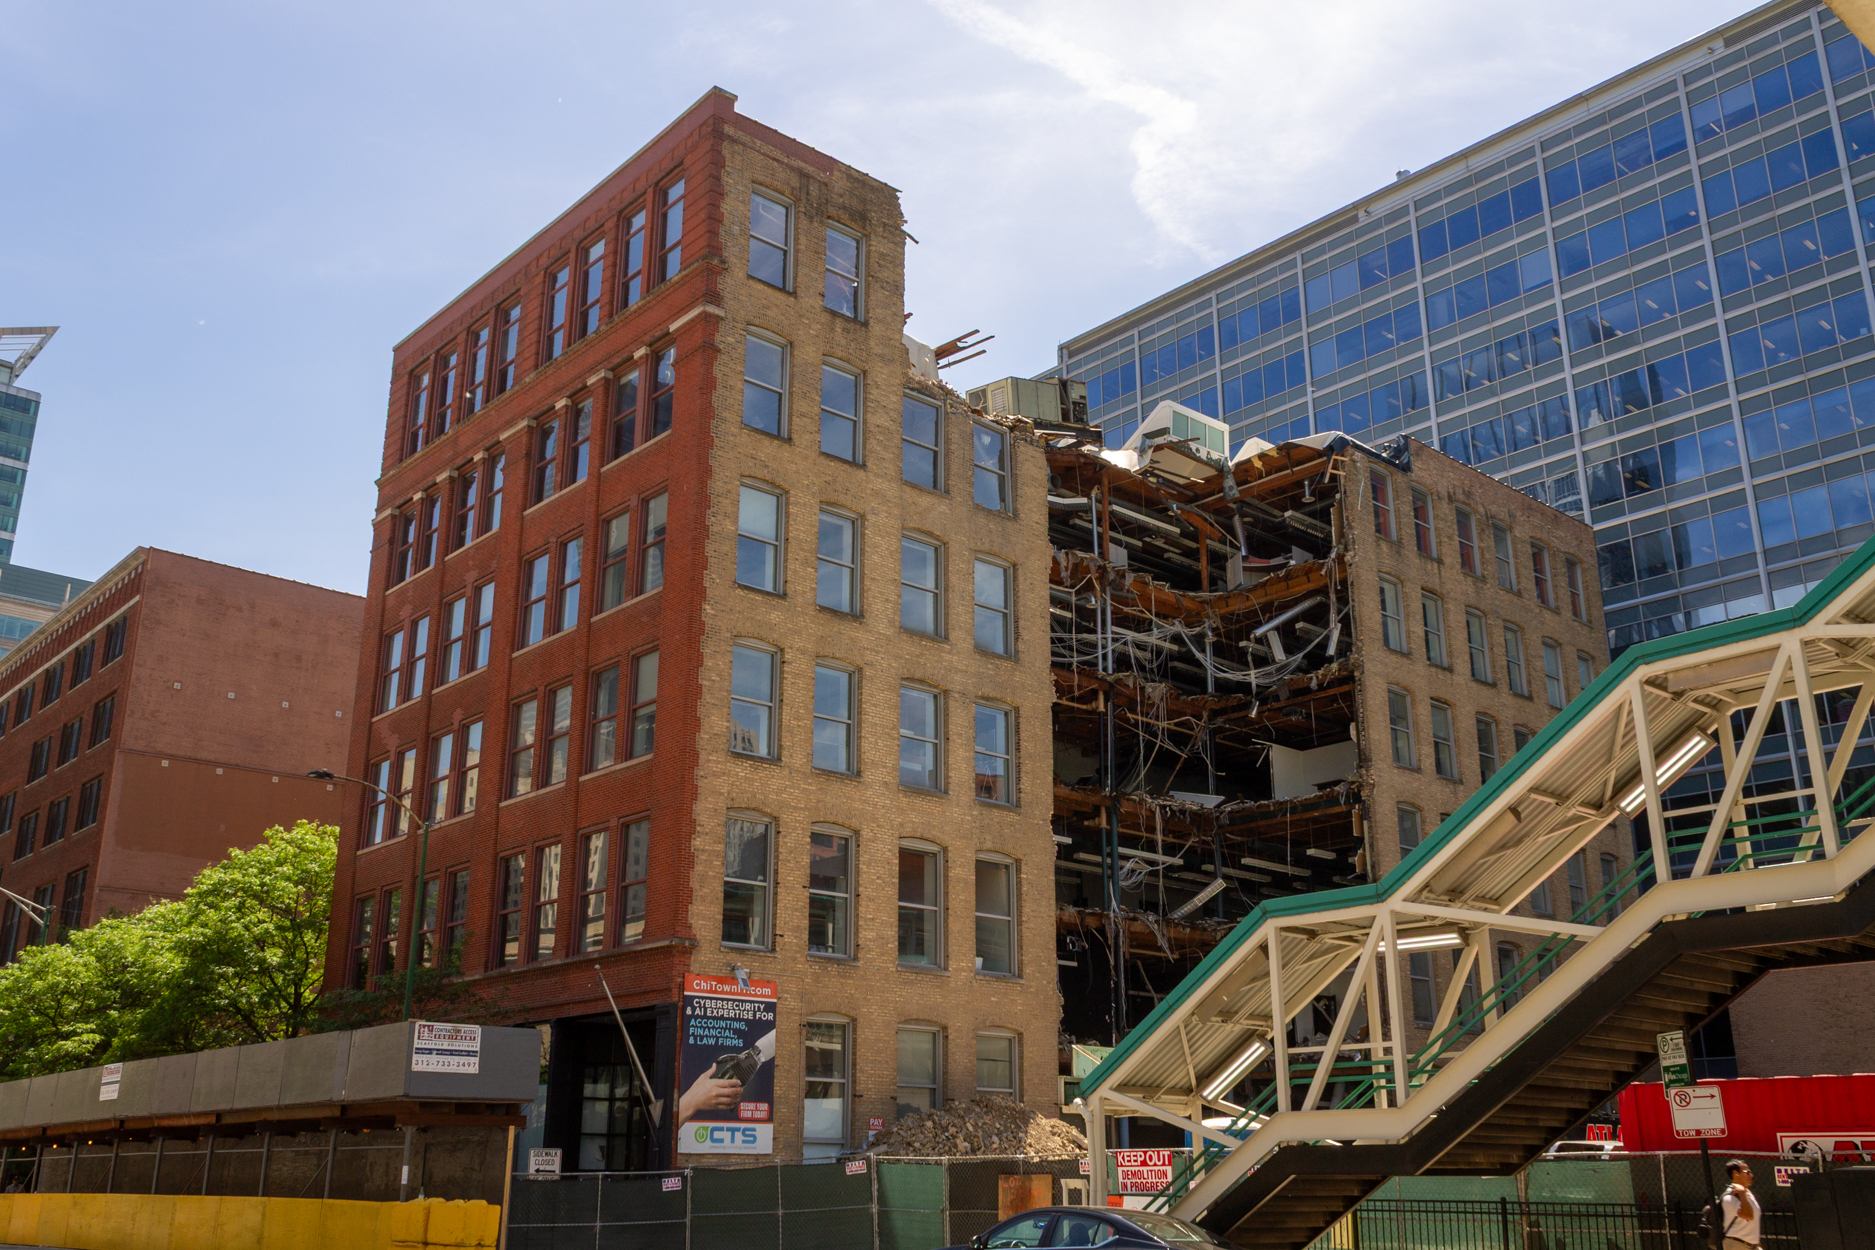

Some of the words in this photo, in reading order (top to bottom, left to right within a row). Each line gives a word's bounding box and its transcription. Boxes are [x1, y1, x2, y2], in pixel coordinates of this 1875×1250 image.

[693, 980, 771, 996] ChiTownI.com
[693, 999, 765, 1011] CYBERSECURITY
[686, 1006, 692, 1015] &
[695, 1007, 704, 1016] AI
[707, 1008, 753, 1019] EXPERTISE
[756, 1012, 773, 1021] FOR
[689, 1018, 748, 1031] ACCOUNTING,
[689, 1027, 738, 1039] FINANCIAL,
[688, 1036, 694, 1044] &
[697, 1037, 716, 1045] LAW
[718, 1038, 743, 1047] FIRMS
[414, 1060, 477, 1068] 312-733-3497
[740, 1102, 756, 1110] SECURE
[741, 1110, 752, 1118] FIRM
[870, 1118, 883, 1126] PAY
[709, 1126, 757, 1144] CTS
[1678, 1129, 1696, 1137] TOW
[1700, 1128, 1722, 1136] ZONE
[1117, 1151, 1145, 1166] KEEP
[1146, 1151, 1170, 1166] OUT
[1121, 1169, 1168, 1180] DEMOLITION
[1002, 1175, 1020, 1187] LOT
[1121, 1181, 1128, 1192] IN
